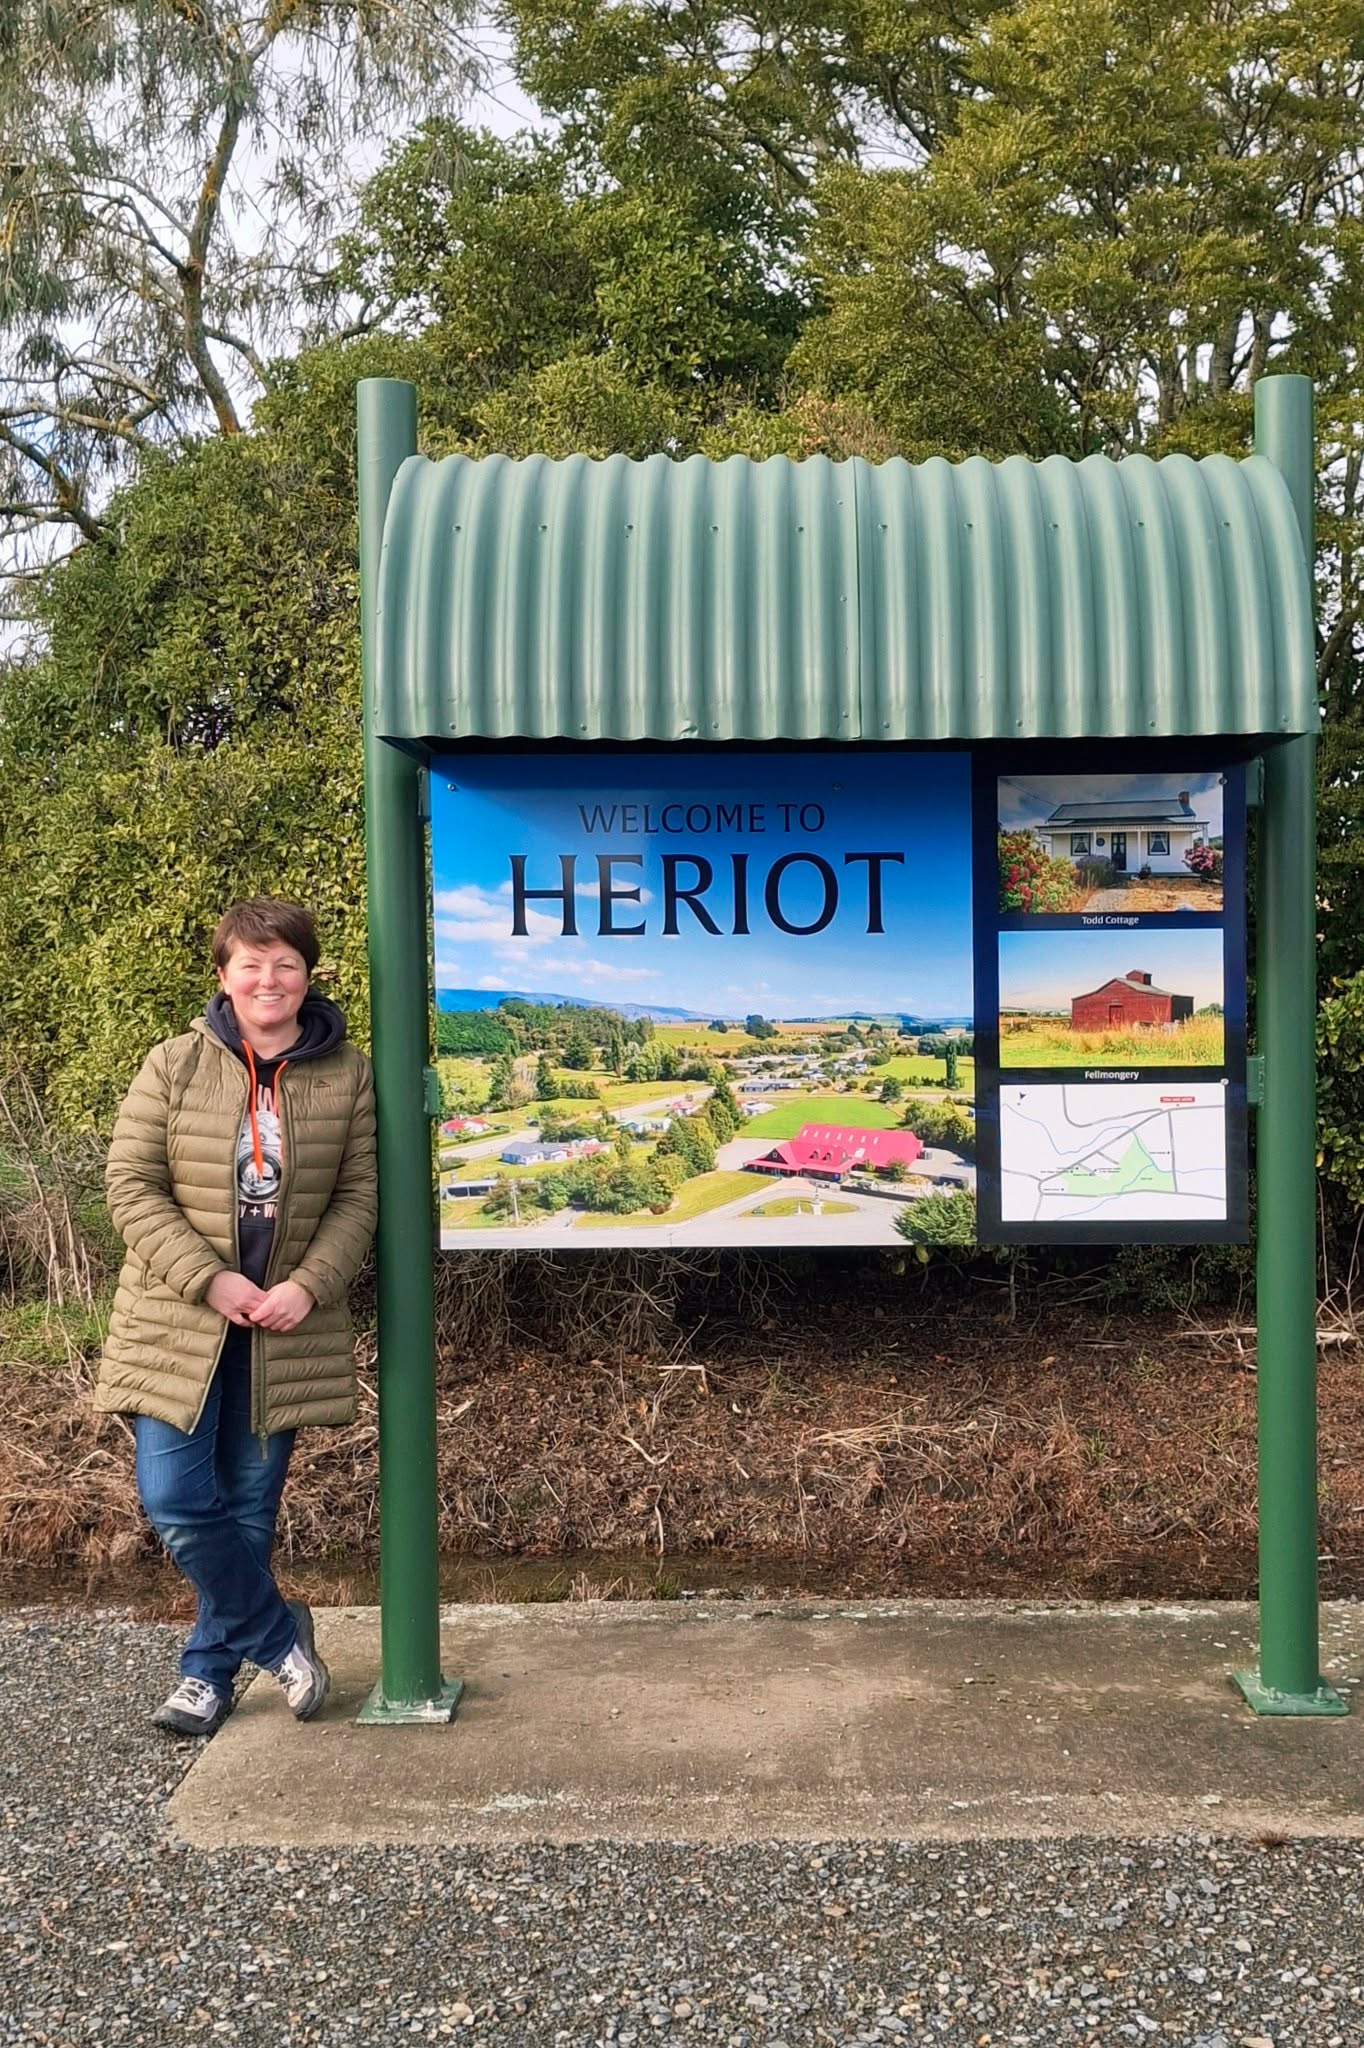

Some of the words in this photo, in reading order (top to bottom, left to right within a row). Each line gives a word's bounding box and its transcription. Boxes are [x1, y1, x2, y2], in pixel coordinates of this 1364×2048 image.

[579, 804, 766, 833] WELCOME
[776, 804, 825, 832] TO
[509, 852, 905, 936] HERIOT
[1082, 916, 1103, 925] Todd
[1105, 916, 1140, 926] Cottage
[1084, 1070, 1140, 1081] Fellmongery
